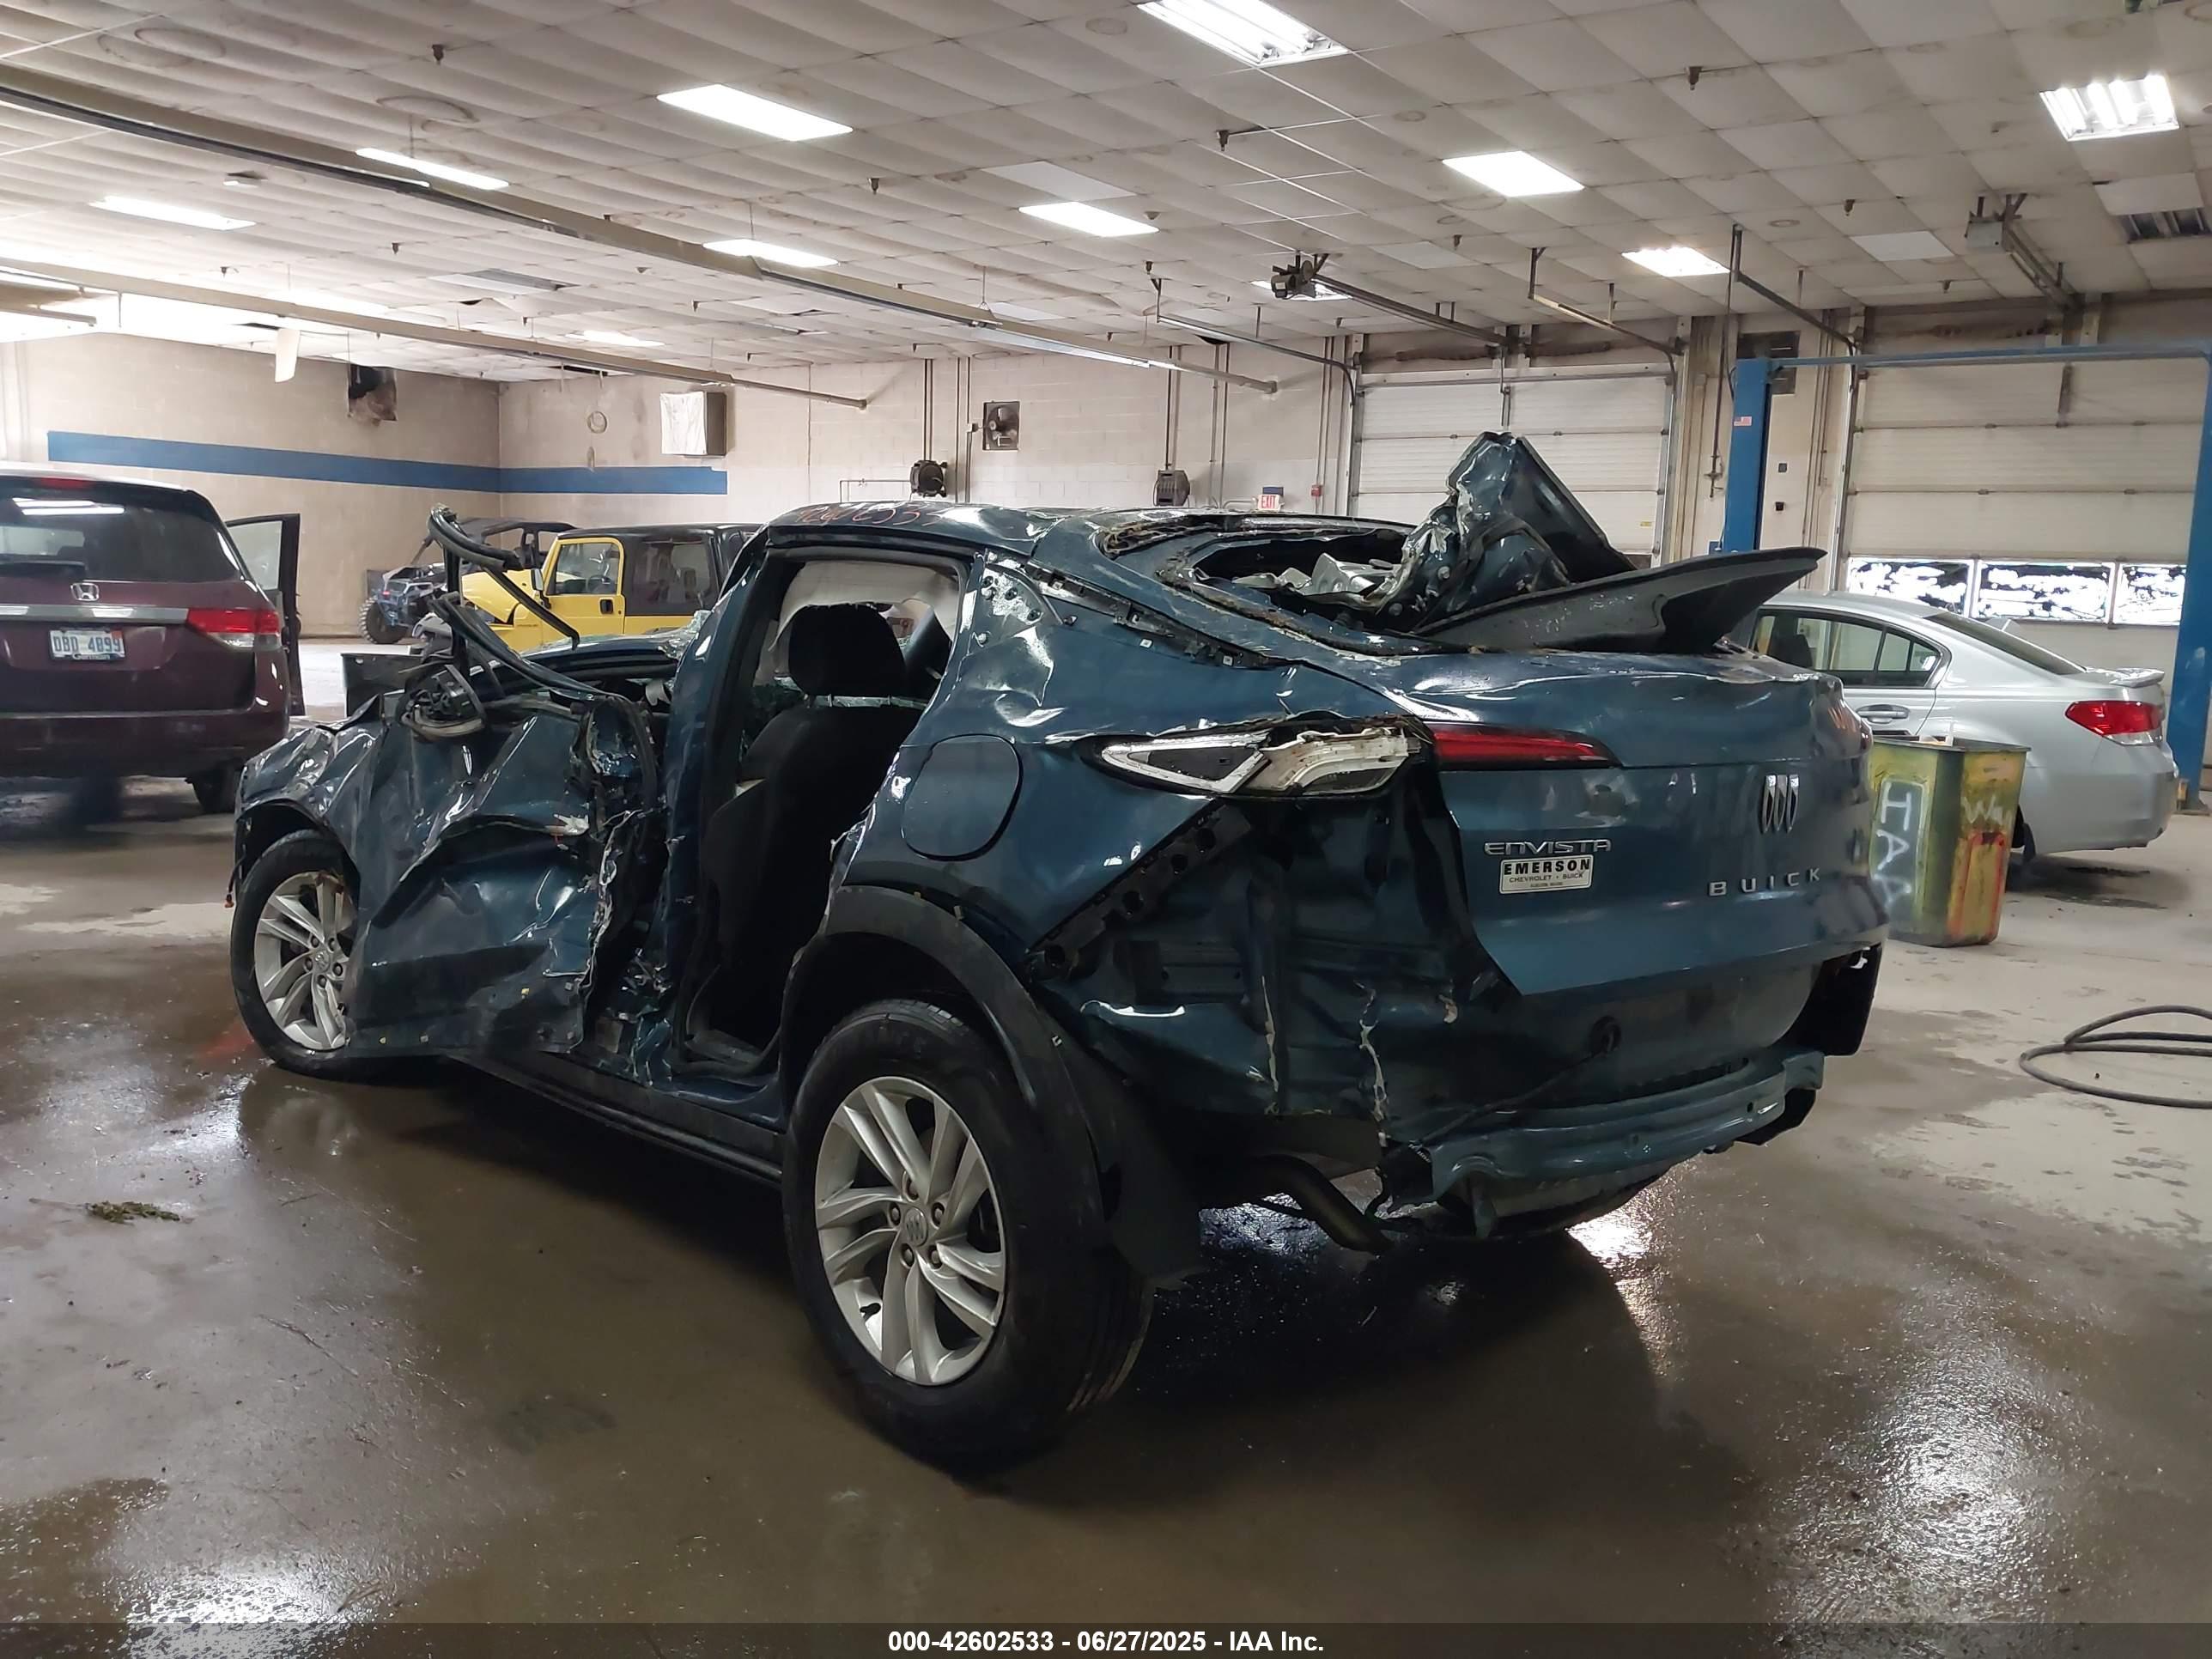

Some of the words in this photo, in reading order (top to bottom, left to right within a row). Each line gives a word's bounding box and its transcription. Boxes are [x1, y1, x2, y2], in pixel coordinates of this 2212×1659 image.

[1261, 495, 1276, 509] EXIT
[88, 636, 121, 653] 4899
[1484, 839, 1611, 855] ENVISTA
[1504, 859, 1589, 876] EMERSON
[1509, 874, 1553, 884] CHEVROLET
[1709, 867, 1820, 896] BUICK
